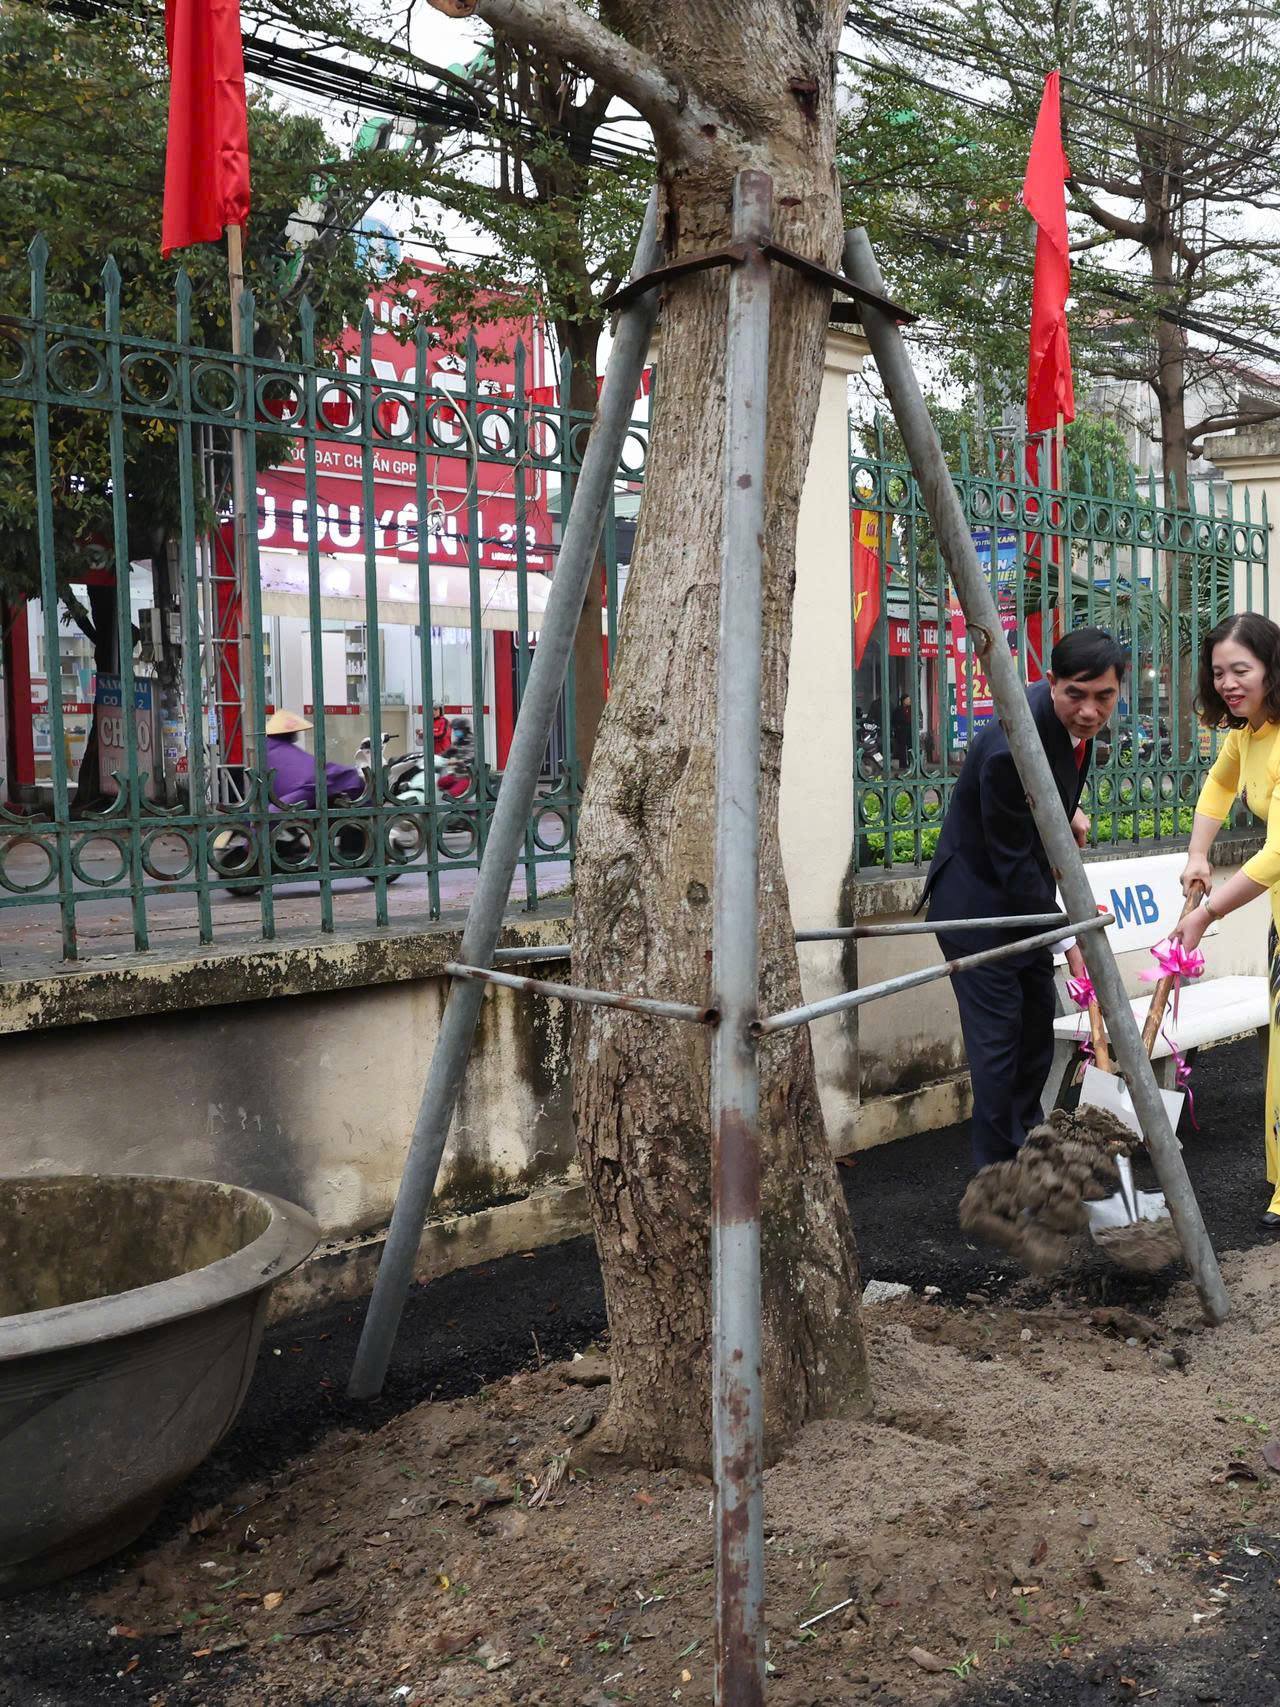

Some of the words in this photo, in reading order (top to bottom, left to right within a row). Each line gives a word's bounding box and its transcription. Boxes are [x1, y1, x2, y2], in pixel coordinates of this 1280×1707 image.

[315, 450, 341, 468] ĐẠT
[344, 452, 390, 473] CHẨN
[393, 460, 417, 475] GPP
[498, 523, 536, 551] 23
[101, 717, 151, 752] CHO
[1110, 884, 1160, 929] MB
